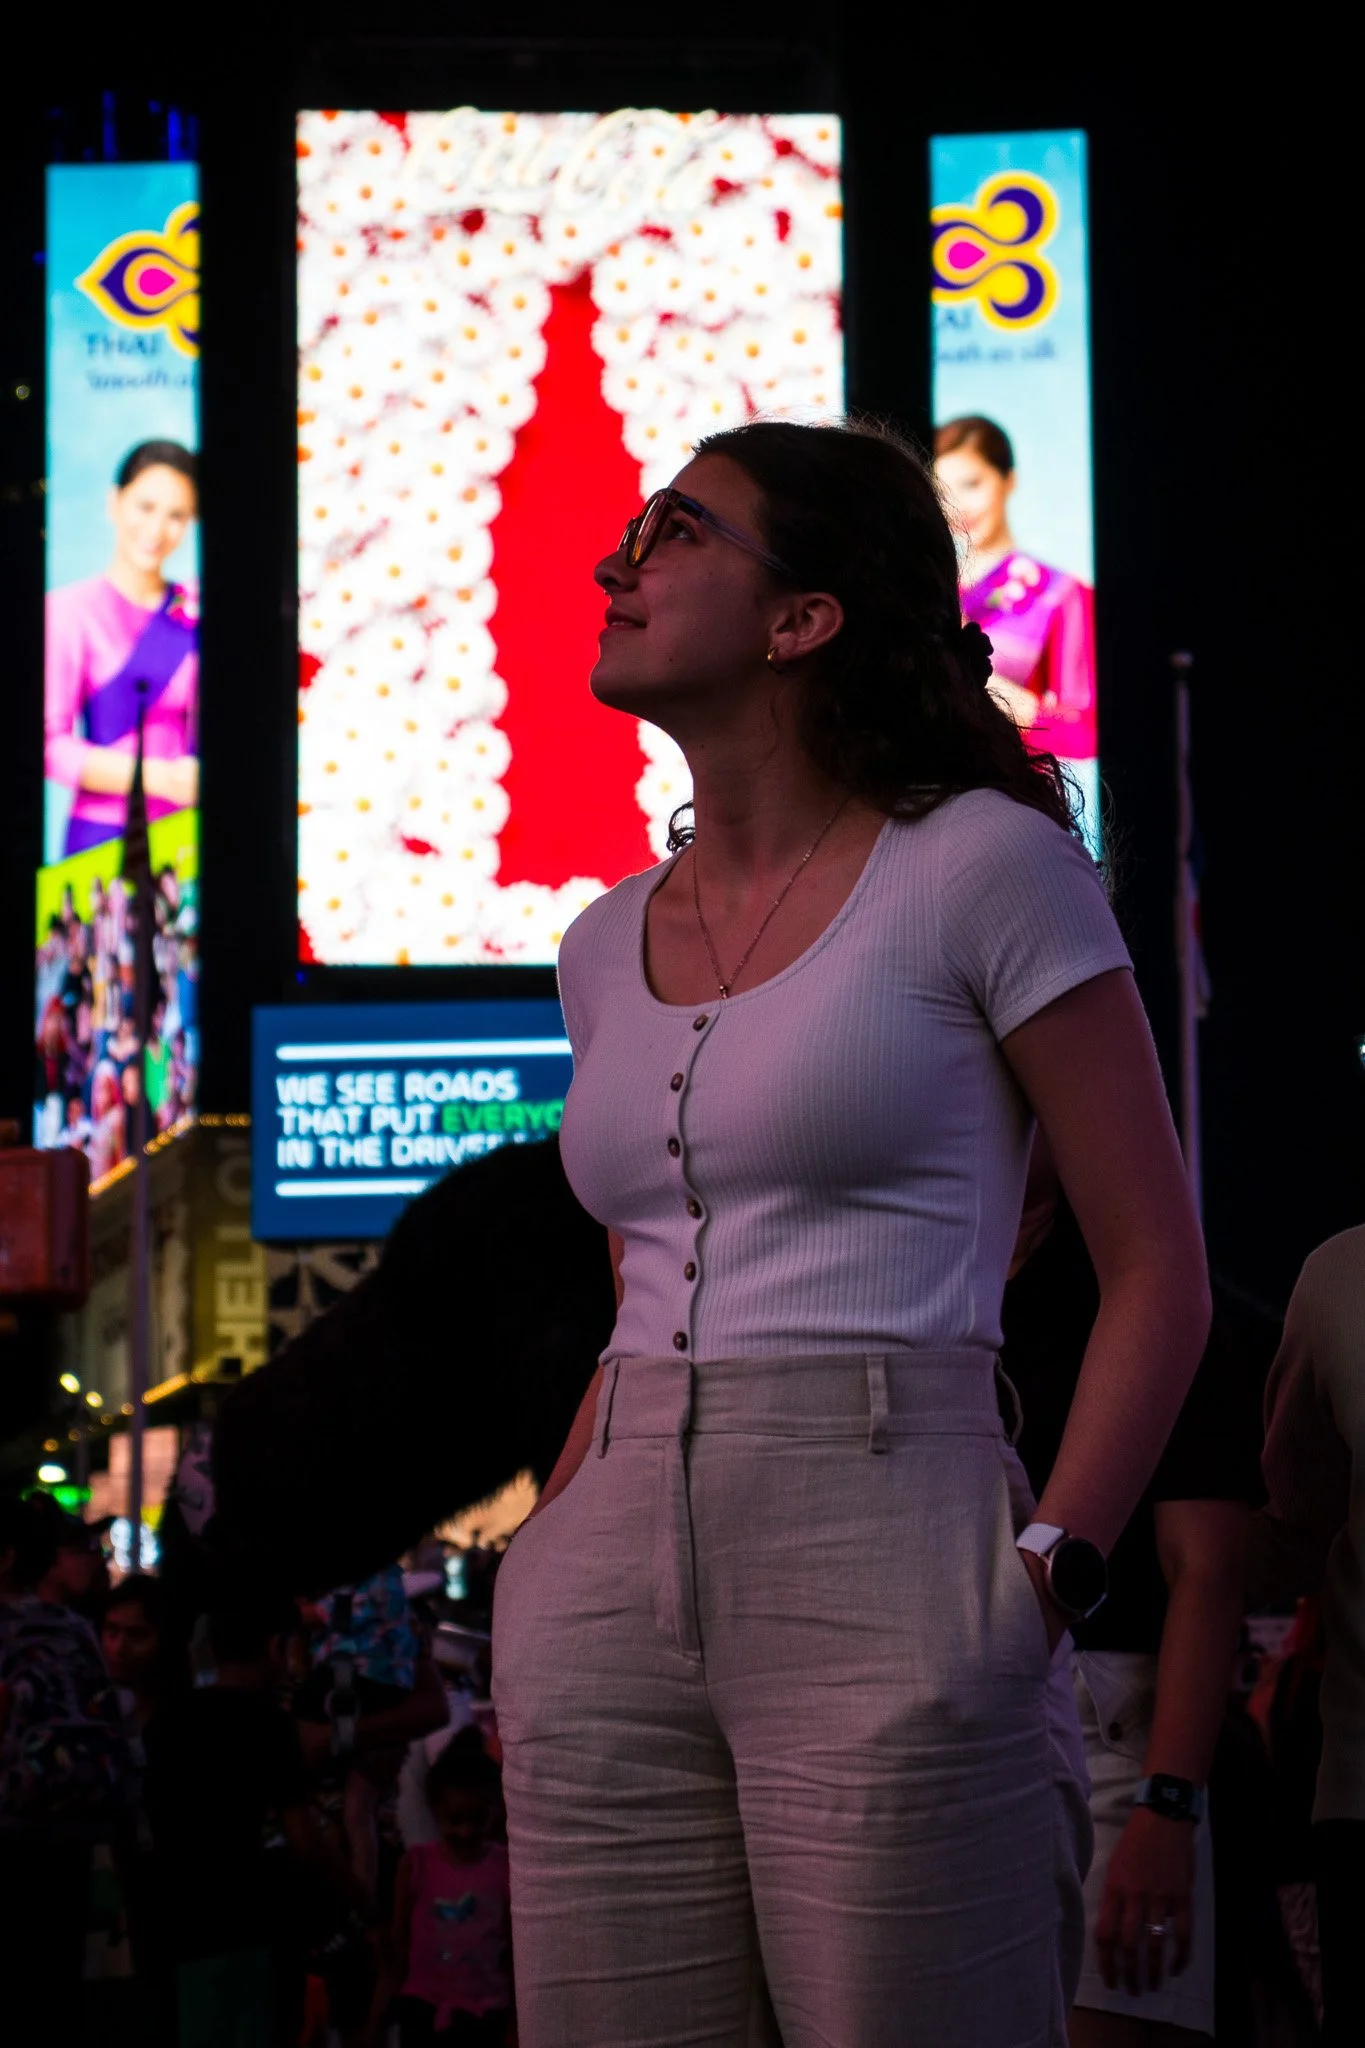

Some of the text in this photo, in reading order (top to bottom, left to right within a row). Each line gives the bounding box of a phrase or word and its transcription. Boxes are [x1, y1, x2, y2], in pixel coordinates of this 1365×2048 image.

[276, 1068, 520, 1105] WE SEE ROADS
[277, 1104, 364, 1135] THAT
[370, 1102, 435, 1134] PUT
[276, 1137, 315, 1169] IN
[318, 1135, 384, 1167] THE
